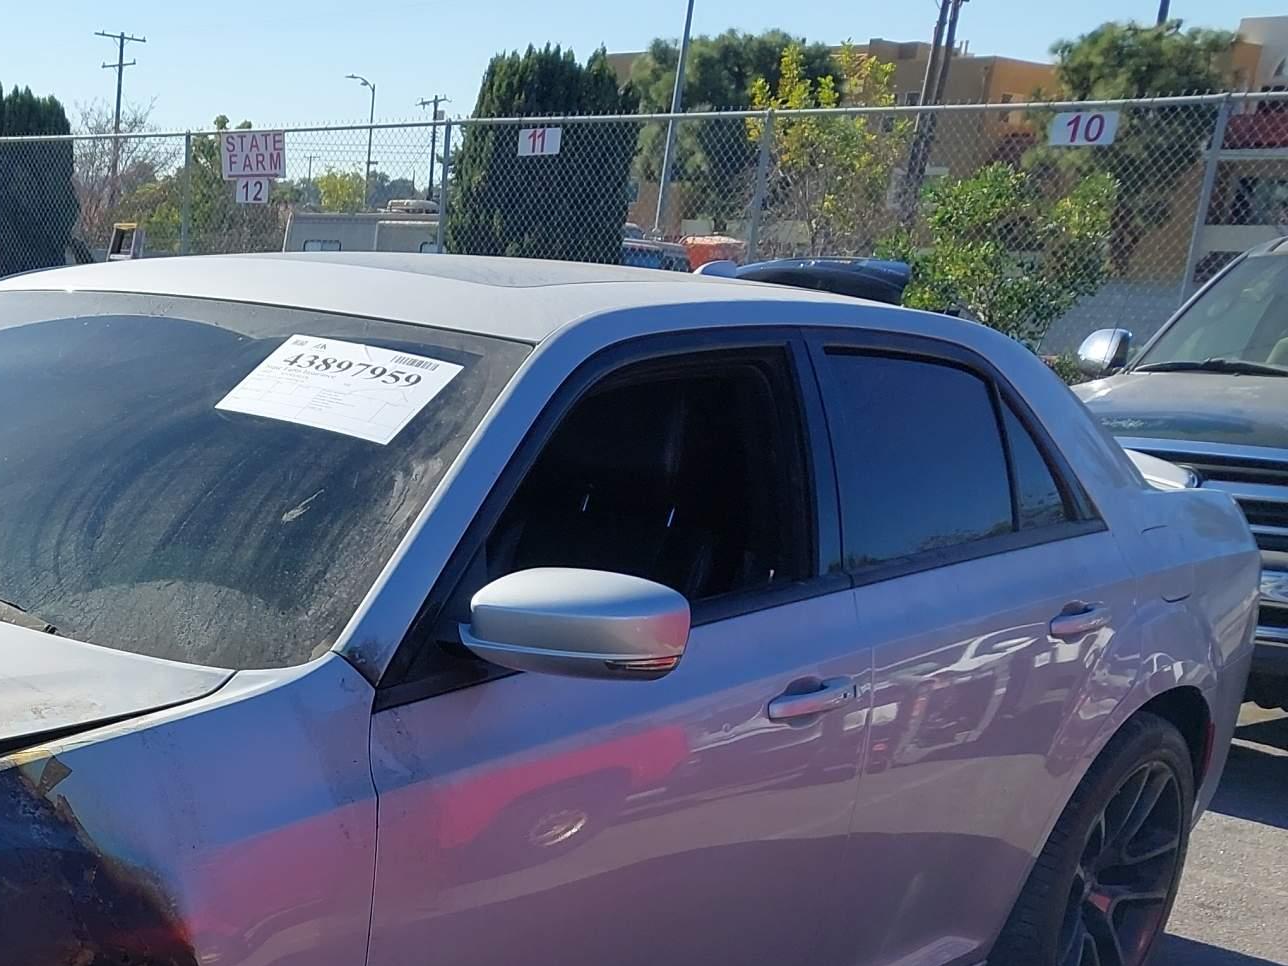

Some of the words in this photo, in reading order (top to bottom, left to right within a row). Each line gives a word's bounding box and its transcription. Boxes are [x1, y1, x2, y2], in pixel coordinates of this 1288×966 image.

[1067, 114, 1105, 143] 10
[226, 133, 283, 152] STATE
[528, 129, 546, 153] 11
[229, 152, 281, 172] FARM
[242, 181, 263, 201] 12
[283, 353, 422, 388] 43897959
